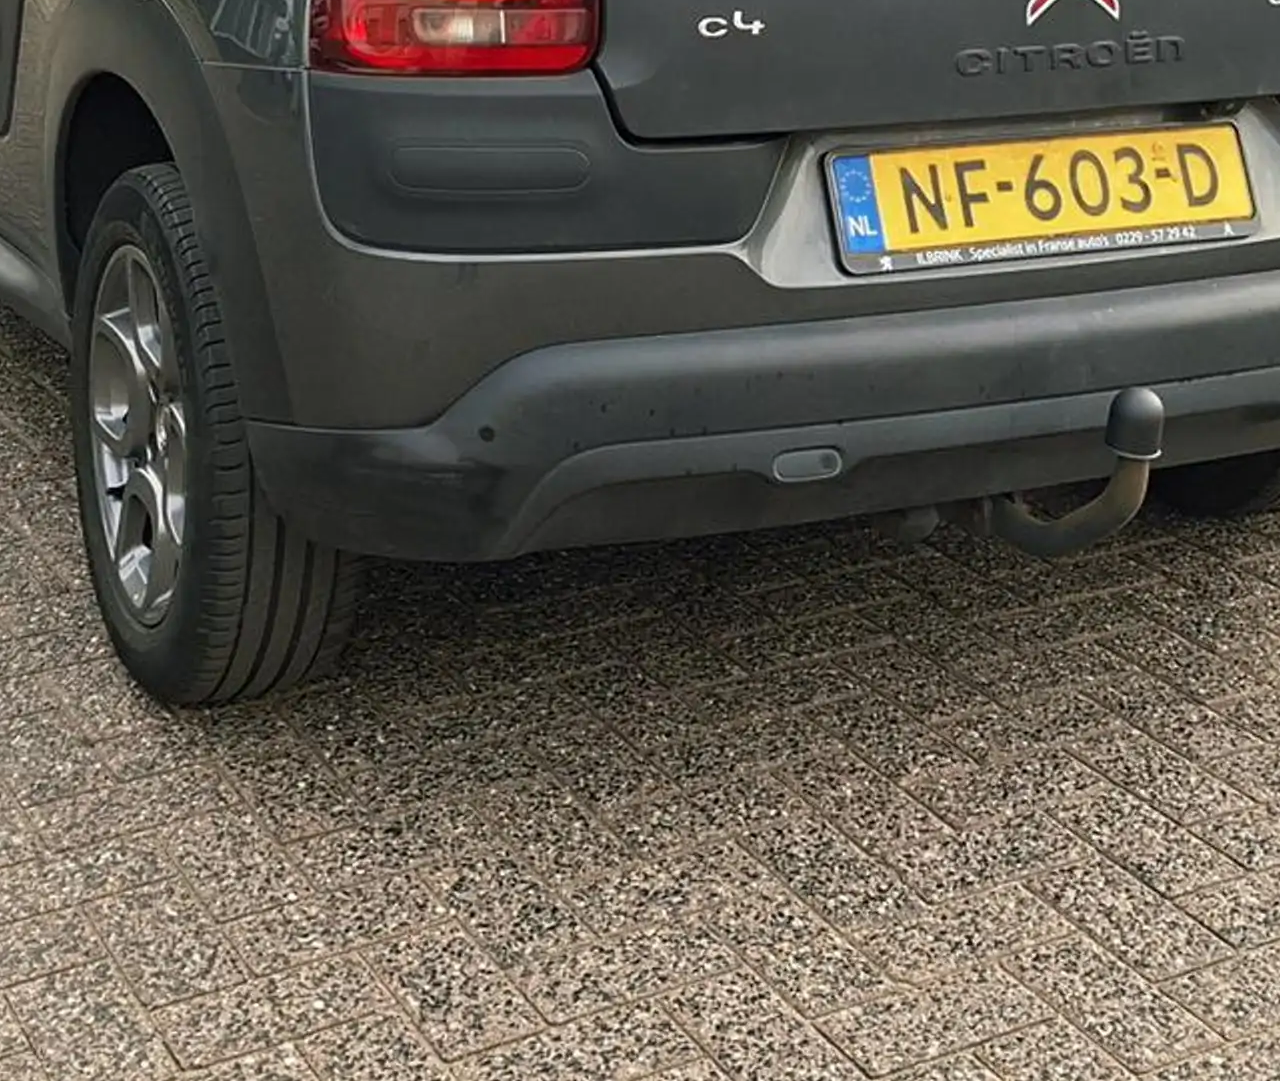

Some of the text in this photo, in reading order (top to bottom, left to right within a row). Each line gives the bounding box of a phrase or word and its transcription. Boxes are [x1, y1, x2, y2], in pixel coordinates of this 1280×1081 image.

[900, 142, 1220, 235] NF-603-D
[849, 213, 878, 239] NL
[916, 248, 963, 265] ILBRINK
[969, 240, 1024, 262] Specialist
[1026, 240, 1038, 253] in
[1038, 236, 1076, 252] Franse
[1115, 229, 1143, 246] 0229
[1151, 228, 1164, 242] 57
